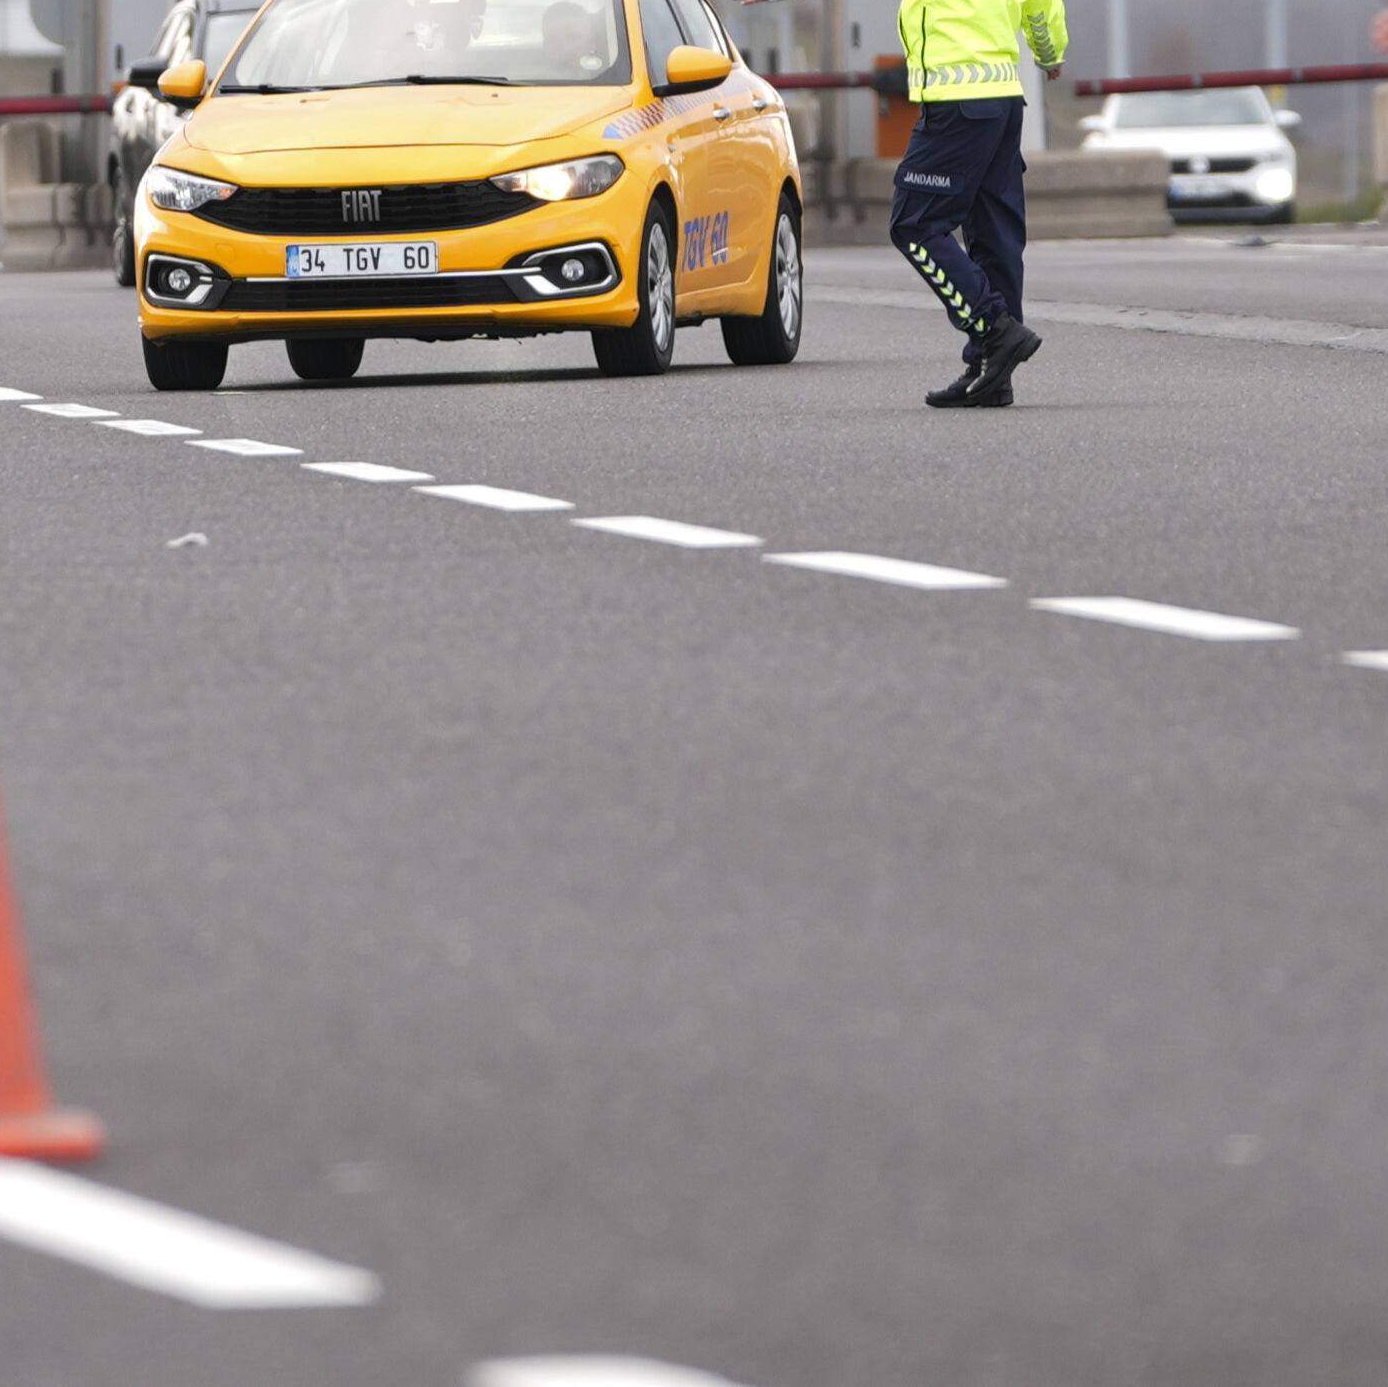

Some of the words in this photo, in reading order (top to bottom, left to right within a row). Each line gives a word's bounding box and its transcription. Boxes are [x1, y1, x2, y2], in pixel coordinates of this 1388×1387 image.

[904, 172, 951, 188] JANDARMA
[341, 190, 382, 222] FIAT
[681, 215, 711, 273] TGV
[710, 210, 729, 265] 60
[301, 249, 325, 272] 34
[343, 247, 381, 271] TGV
[404, 246, 429, 269] 60
